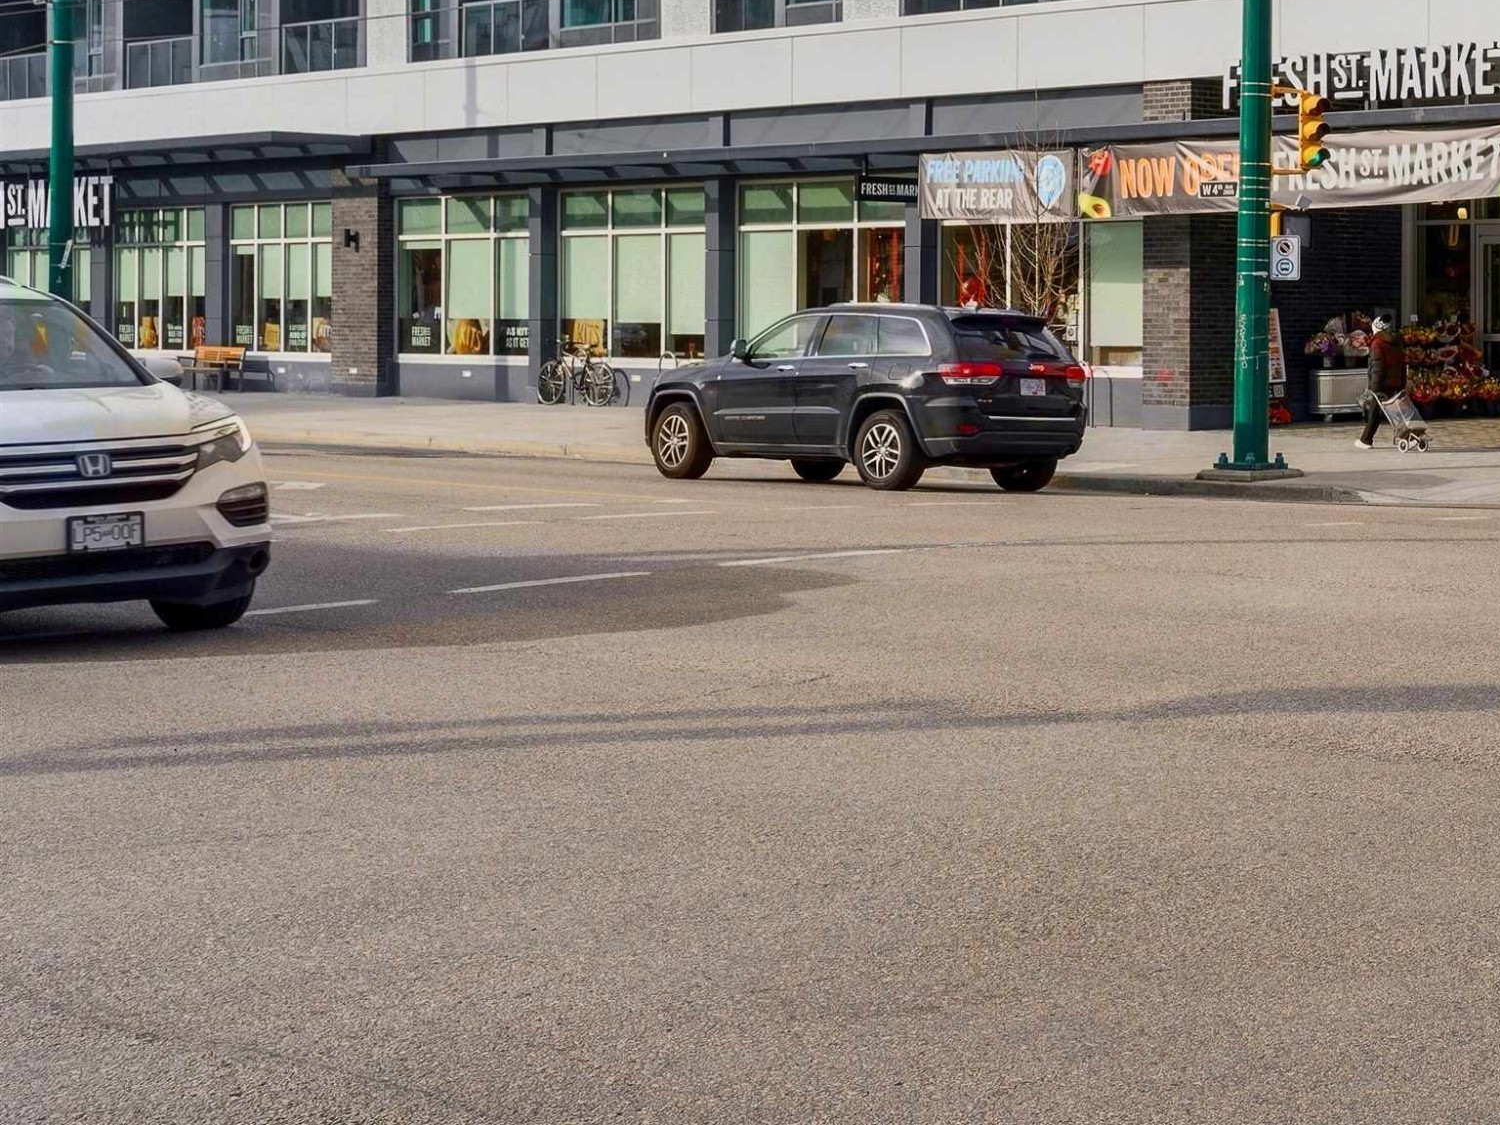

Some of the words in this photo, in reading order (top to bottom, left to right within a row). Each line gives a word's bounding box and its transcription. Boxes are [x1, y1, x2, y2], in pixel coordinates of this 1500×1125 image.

[927, 159, 960, 183] FREE
[1119, 156, 1175, 199] NOW
[861, 183, 888, 195] FRESH
[936, 189, 950, 209] AT
[955, 188, 977, 209] THE
[981, 188, 1013, 209] REAR
[1202, 184, 1211, 195] W
[28, 176, 113, 228] MKET
[1028, 363, 1045, 372] Jeep
